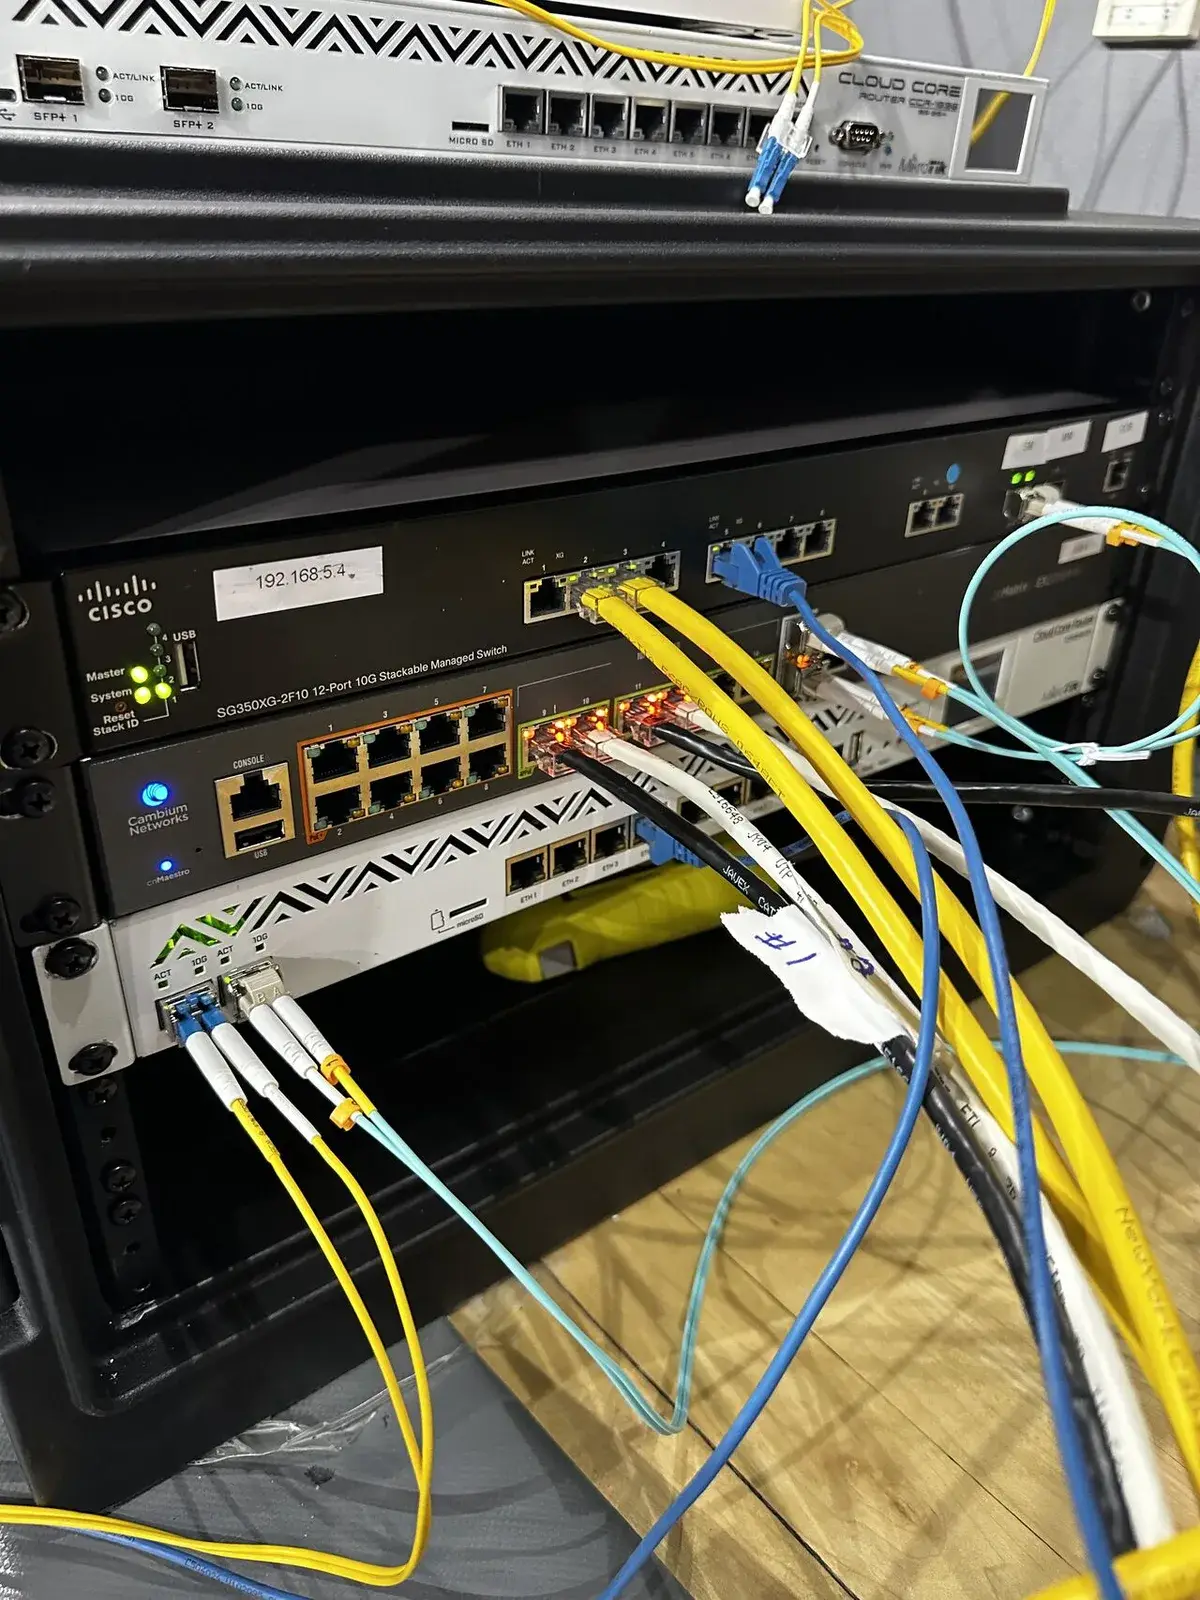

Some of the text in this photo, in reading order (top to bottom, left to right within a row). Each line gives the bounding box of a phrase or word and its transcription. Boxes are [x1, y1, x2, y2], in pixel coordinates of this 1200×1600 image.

[112, 72, 156, 83] ACT/LINK
[244, 82, 284, 92] ACT/LINK
[838, 71, 961, 98] CLOUD CORE
[115, 94, 134, 103] 10G
[858, 92, 906, 104] ROUTER
[246, 103, 264, 111] 10G
[34, 111, 78, 123] SFP+ 1
[173, 119, 214, 131] SFP+ 2
[449, 136, 479, 147] MICRO
[506, 139, 525, 149] ETH
[551, 142, 575, 151] ETH 2
[593, 145, 617, 154] ETH 3
[660, 540, 666, 548] 4
[521, 549, 535, 558] LINK
[622, 547, 628, 556] 3
[522, 557, 535, 566] ACT
[583, 555, 589, 564] 2
[541, 563, 546, 573] 1
[162, 633, 168, 643] 4
[172, 629, 197, 642] USB
[165, 654, 171, 664] 3
[86, 667, 126, 683] Master
[168, 675, 175, 684] 2
[216, 643, 508, 719] SG350XG-2F10 12-Port 10G Stackable Managed Switch
[482, 686, 488, 694] 7
[90, 688, 133, 704] System
[172, 695, 177, 703] 1
[434, 698, 440, 706] 5
[103, 709, 136, 725] Reset
[382, 710, 388, 719] 3
[542, 709, 547, 717] 9
[93, 718, 140, 737] Stack ID
[328, 724, 334, 733] 1
[233, 754, 265, 771] CONSOLE
[127, 804, 189, 829] Cambium
[389, 812, 395, 821] 4
[129, 812, 190, 837] Networks
[336, 828, 342, 836] 2
[254, 849, 268, 860] USB
[602, 861, 619, 872] ETH 3
[146, 868, 191, 888] cnMaestro
[562, 875, 580, 888] ETH 2
[520, 893, 533, 904] ETH
[457, 912, 484, 929] microSD
[253, 932, 268, 944] 10G
[217, 945, 234, 958] ACT
[191, 955, 208, 967] 10G
[154, 968, 172, 981] ACT
[256, 986, 281, 1003] B A
